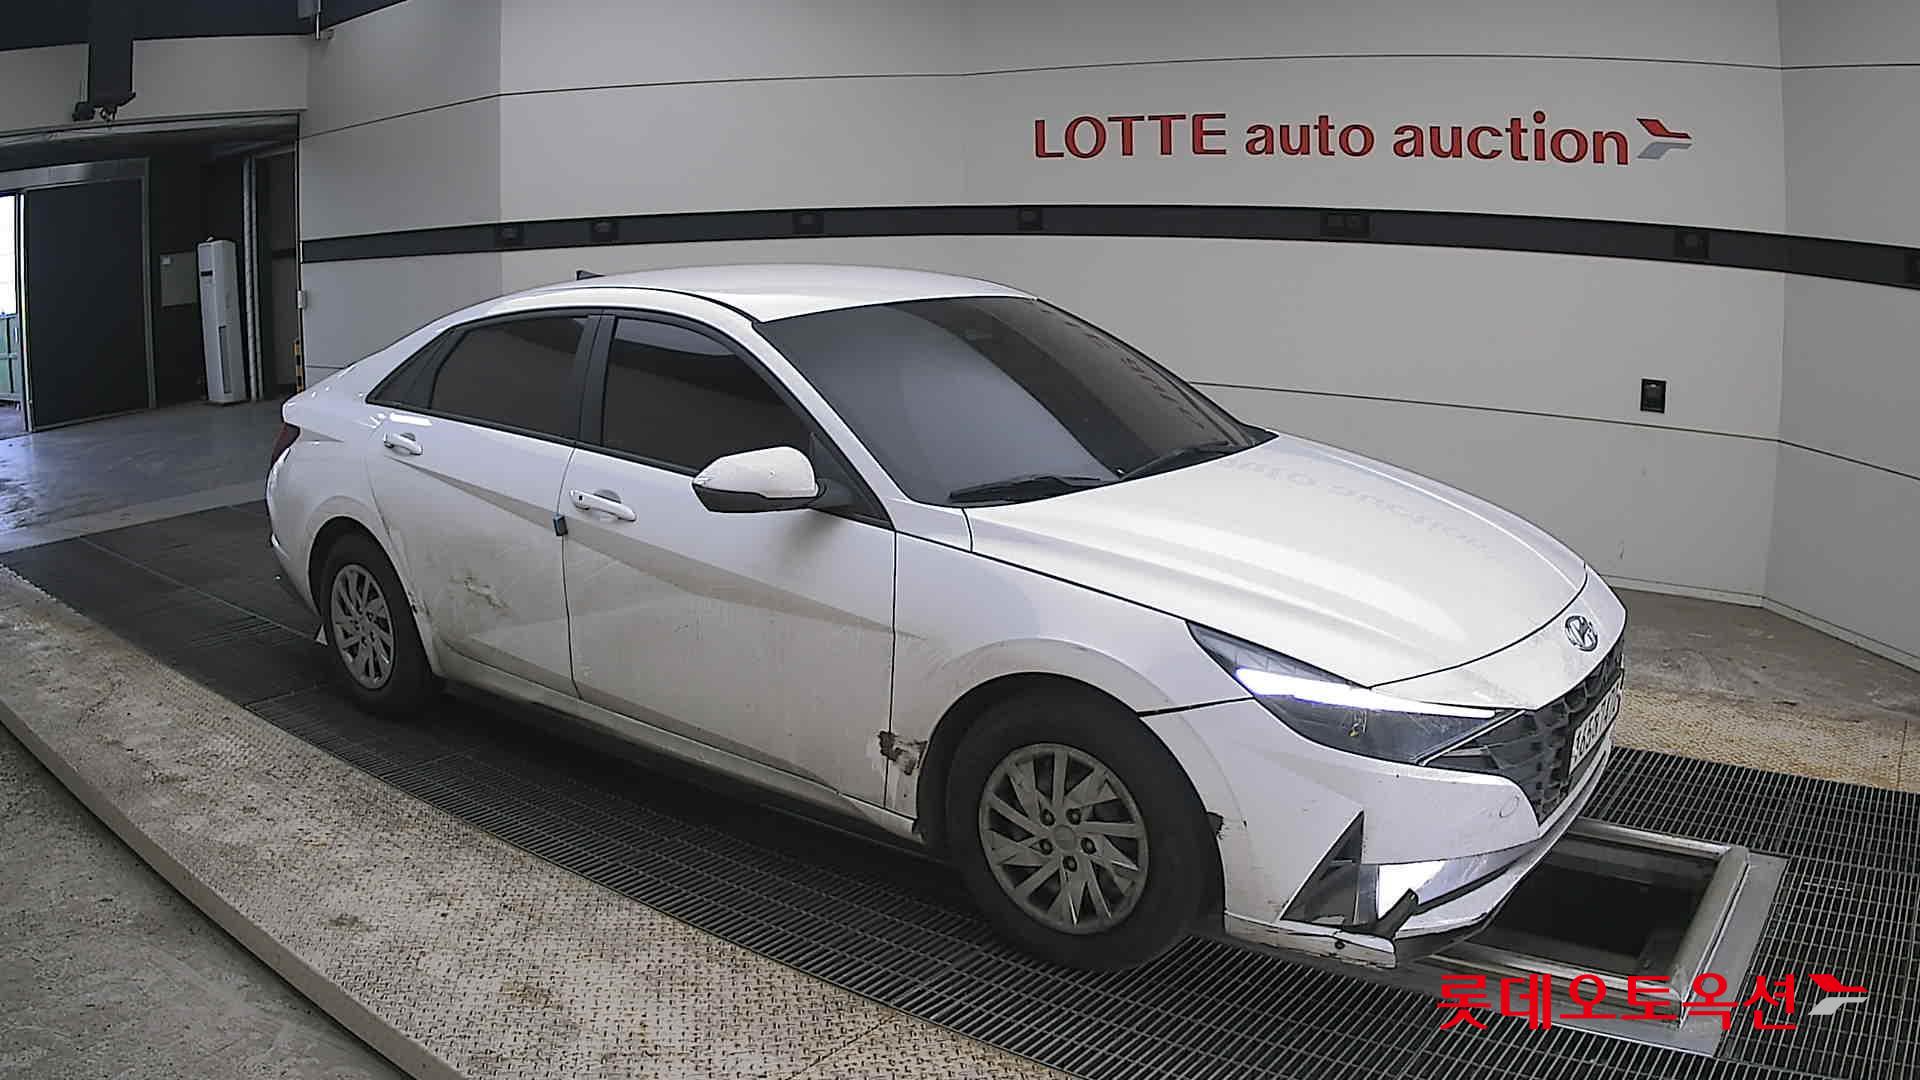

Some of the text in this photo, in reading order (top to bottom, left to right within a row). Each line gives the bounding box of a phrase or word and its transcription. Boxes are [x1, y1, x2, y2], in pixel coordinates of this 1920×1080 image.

[1034, 110, 1629, 165] LOTTE auto auction
